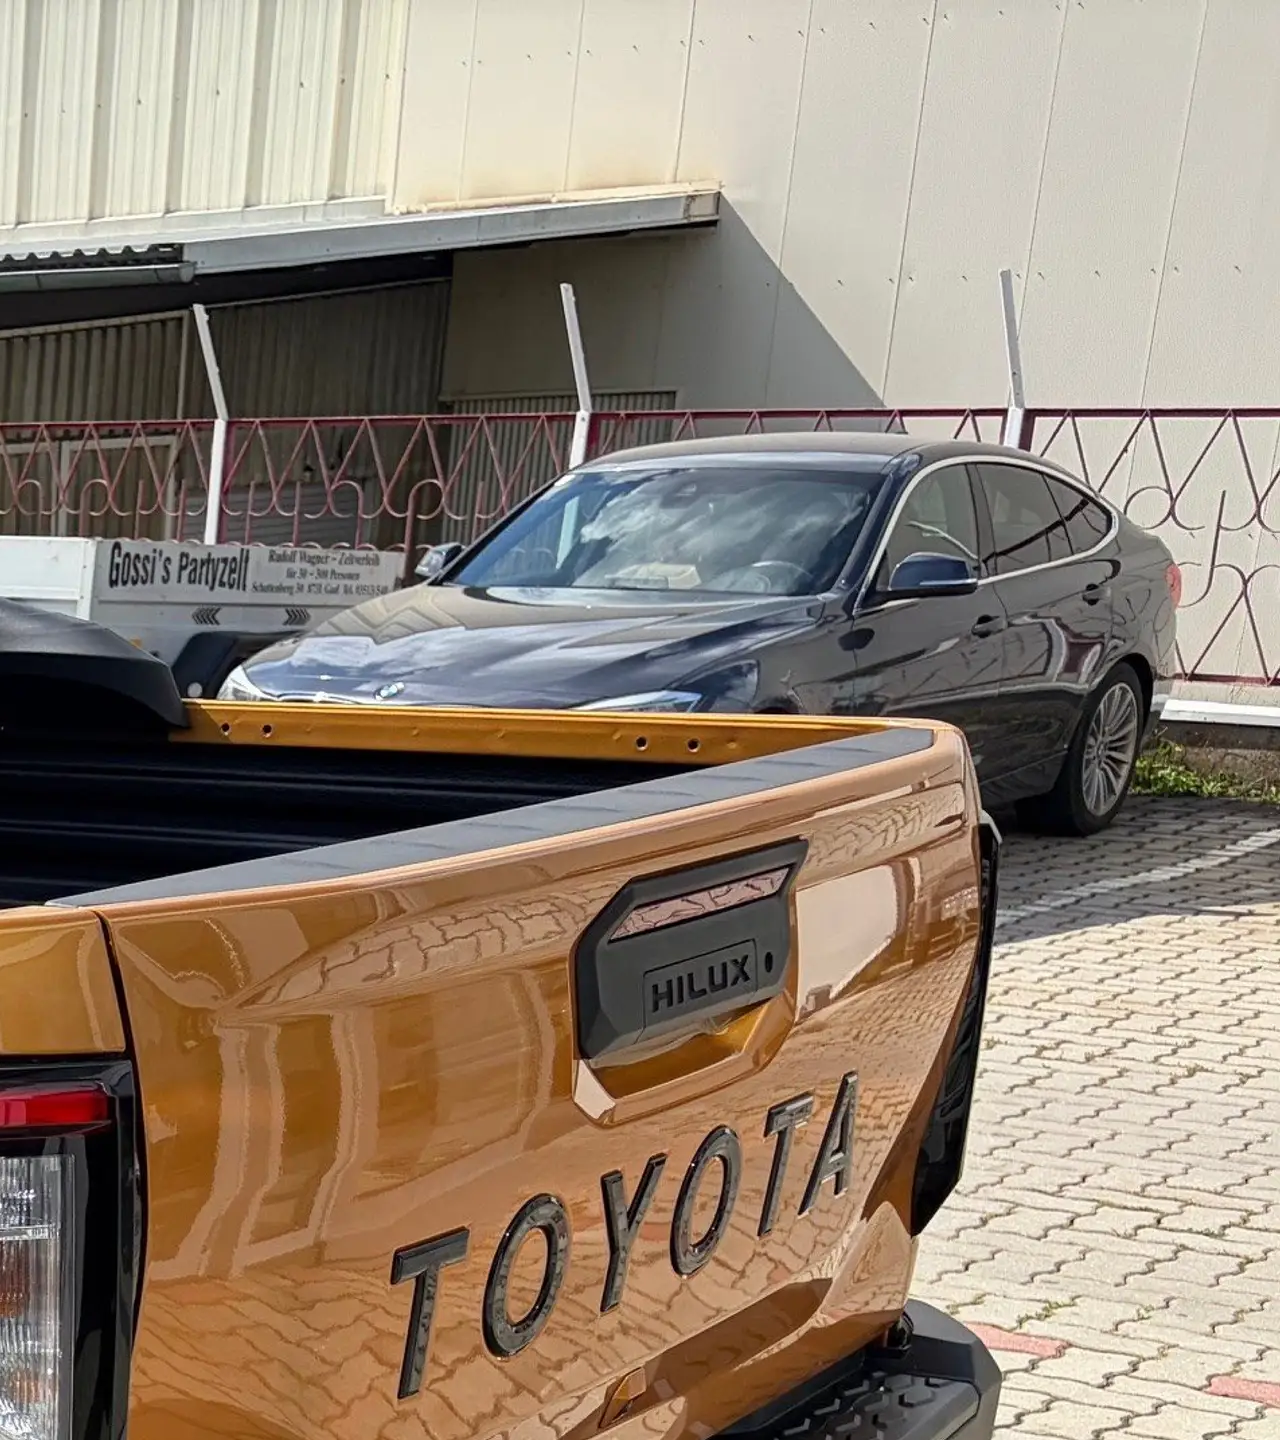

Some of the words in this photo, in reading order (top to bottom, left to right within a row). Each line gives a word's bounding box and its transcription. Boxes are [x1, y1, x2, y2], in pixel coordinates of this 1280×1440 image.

[108, 541, 172, 588] Gossi's
[268, 549, 296, 563] Rudolf
[299, 551, 330, 566] Wagner
[650, 955, 753, 1013] HILUX
[390, 1071, 860, 1400] TOYOTA
